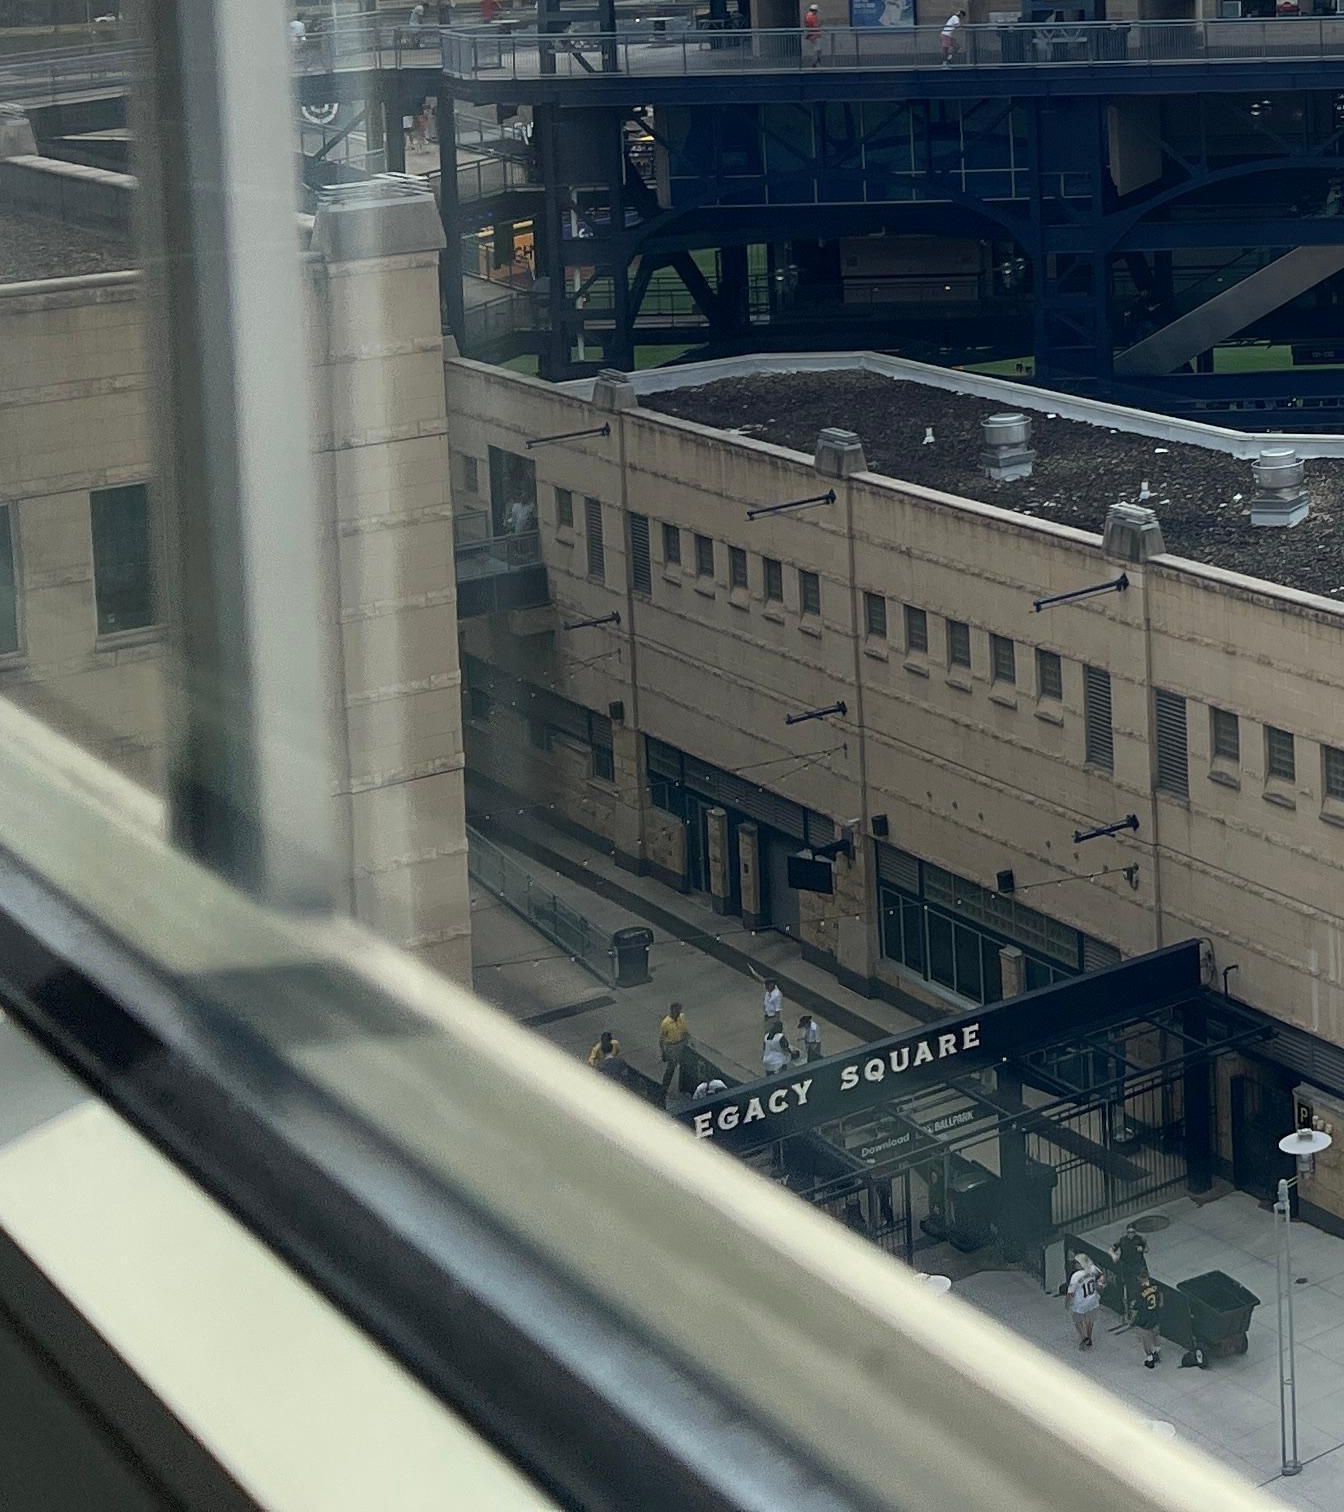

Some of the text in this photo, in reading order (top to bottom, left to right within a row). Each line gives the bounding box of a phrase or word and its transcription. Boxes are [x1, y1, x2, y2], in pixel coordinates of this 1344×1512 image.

[693, 1023, 981, 1139] EGACY SQUARE
[934, 1110, 974, 1132] BALLPARK
[861, 1132, 911, 1158] Download
